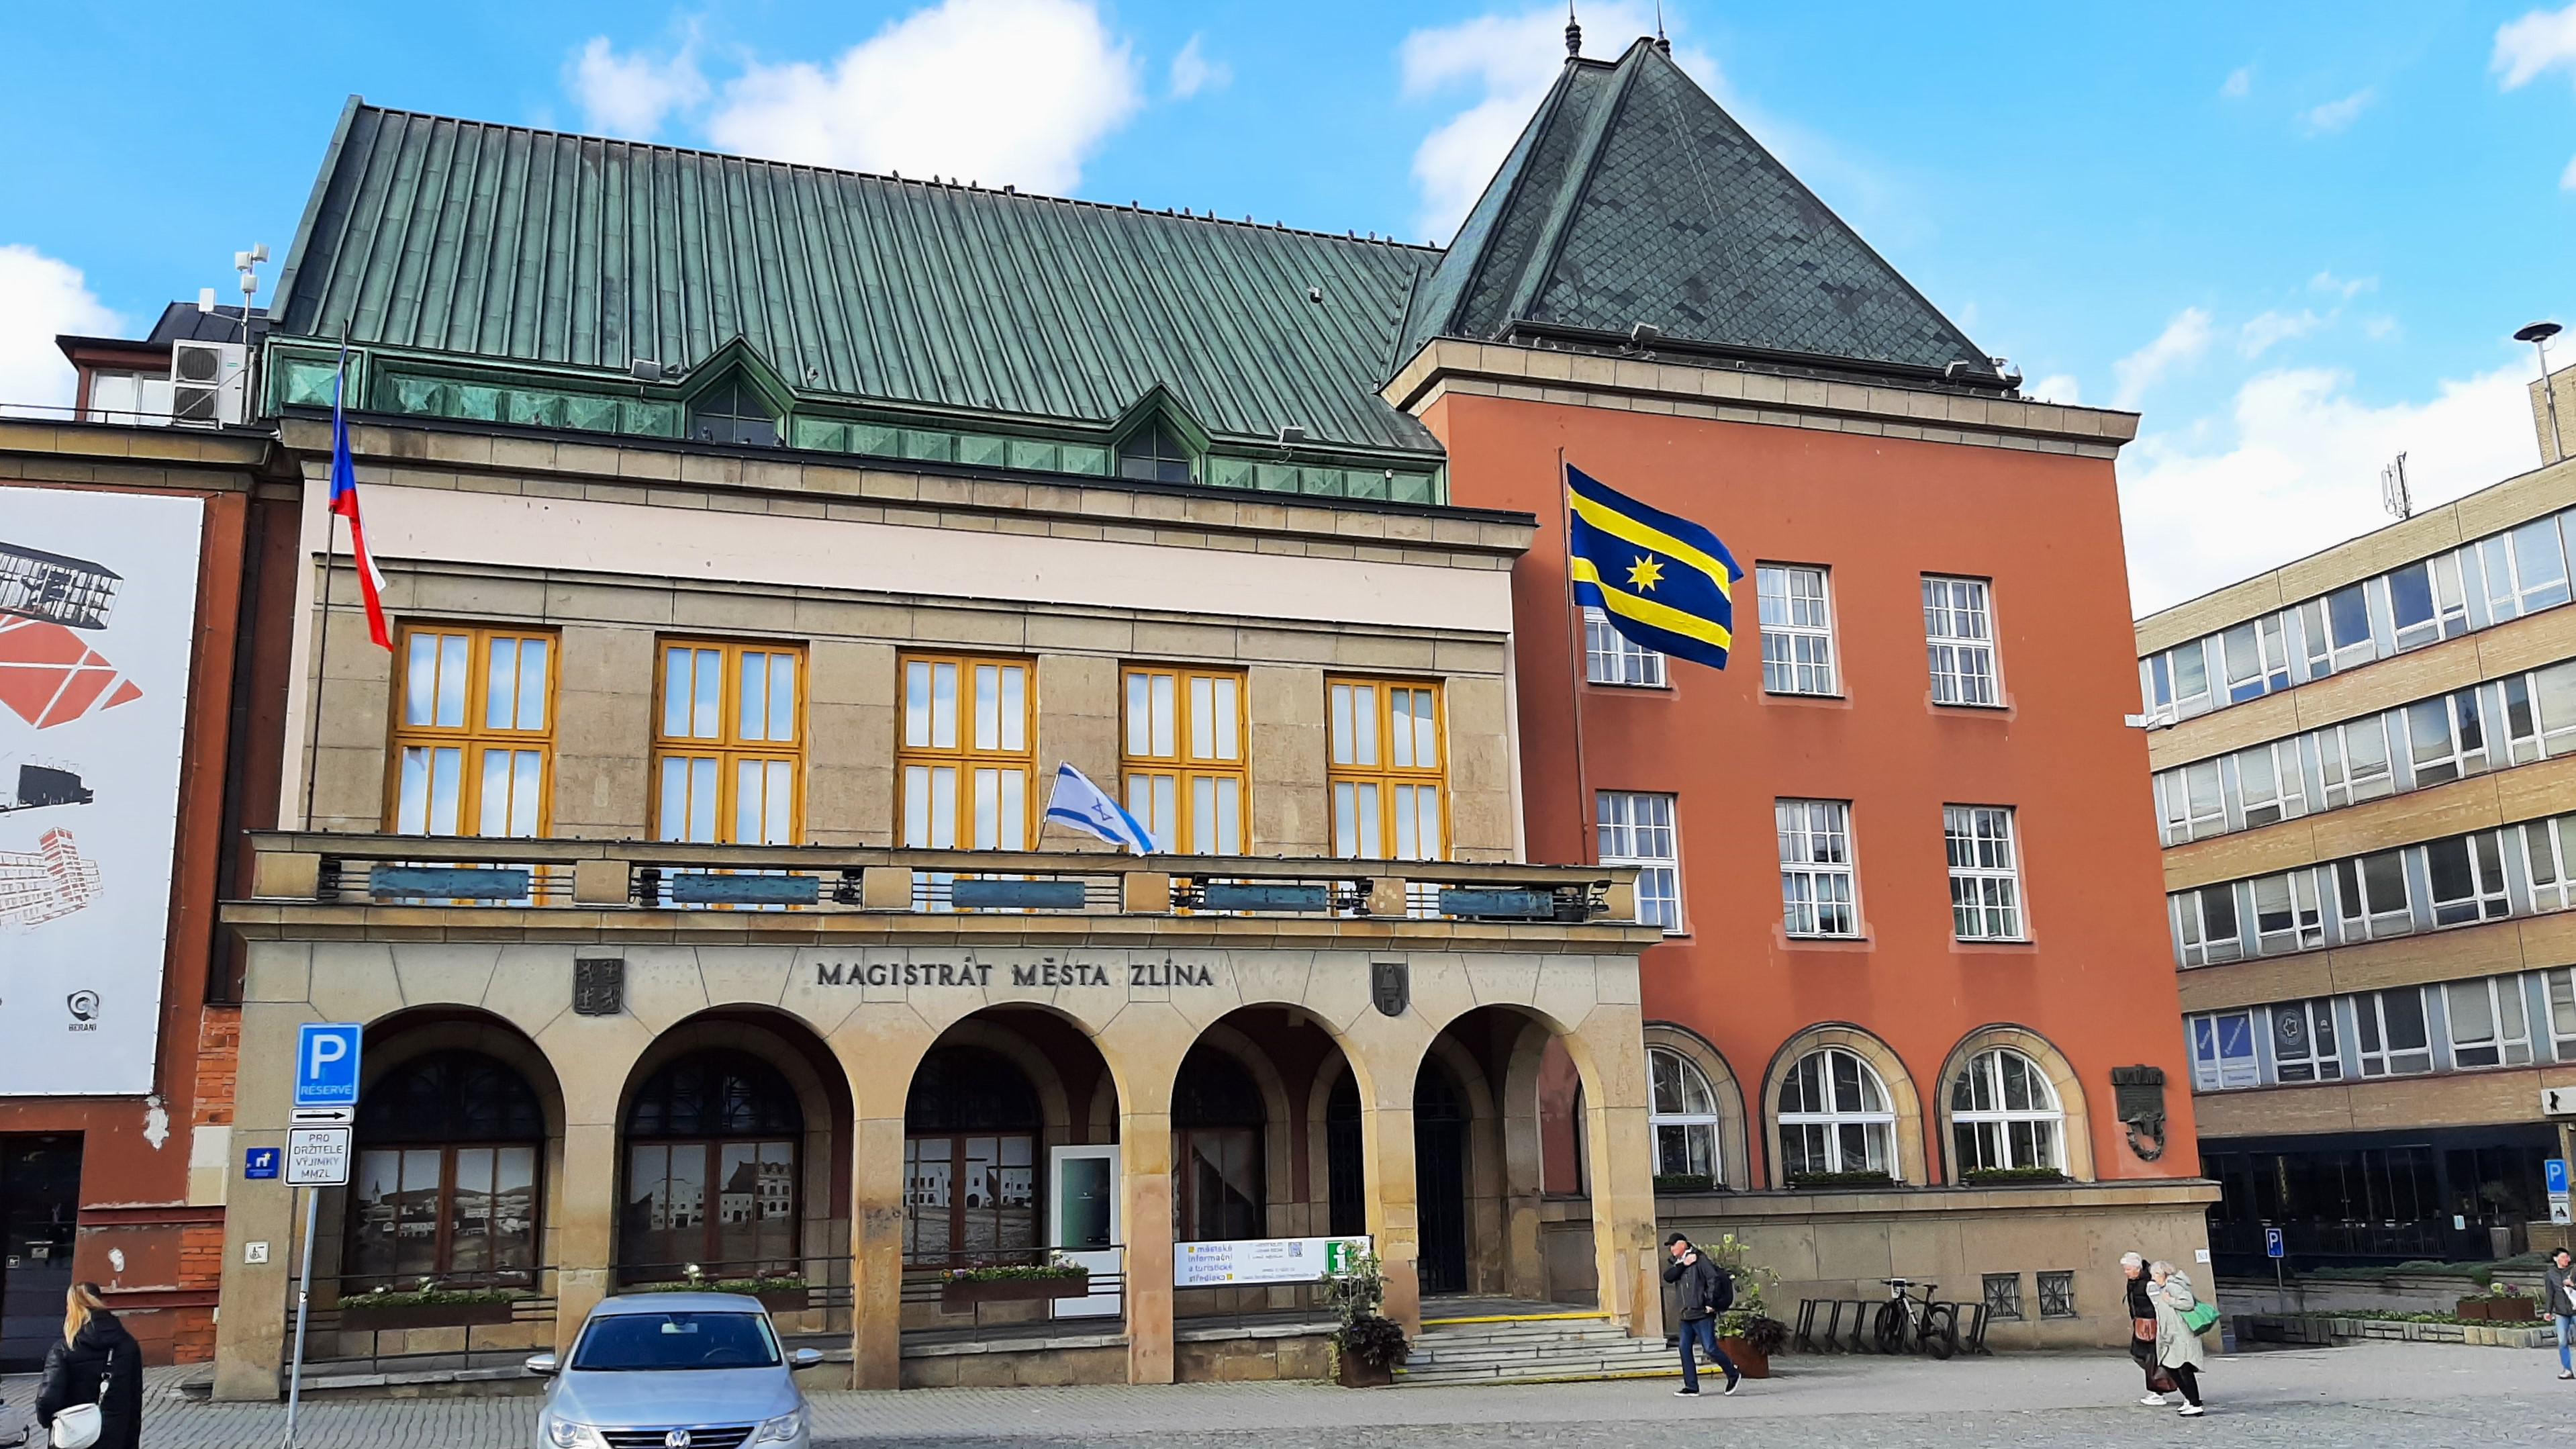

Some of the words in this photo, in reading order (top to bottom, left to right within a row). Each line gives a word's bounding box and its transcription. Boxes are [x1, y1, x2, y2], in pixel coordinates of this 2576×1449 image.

[817, 956, 992, 986] MAGISTRÁT
[1012, 957, 1109, 986] MĚSTA
[1131, 957, 1213, 986] ZLÍNA
[310, 1034, 346, 1079] P
[309, 1133, 330, 1142] PRO
[294, 1144, 344, 1154] DRŽITELE
[296, 1156, 339, 1166] VÝJIMKY
[301, 1169, 331, 1178] MMZL
[2550, 1164, 2561, 1182] P
[2269, 1232, 2278, 1248] P
